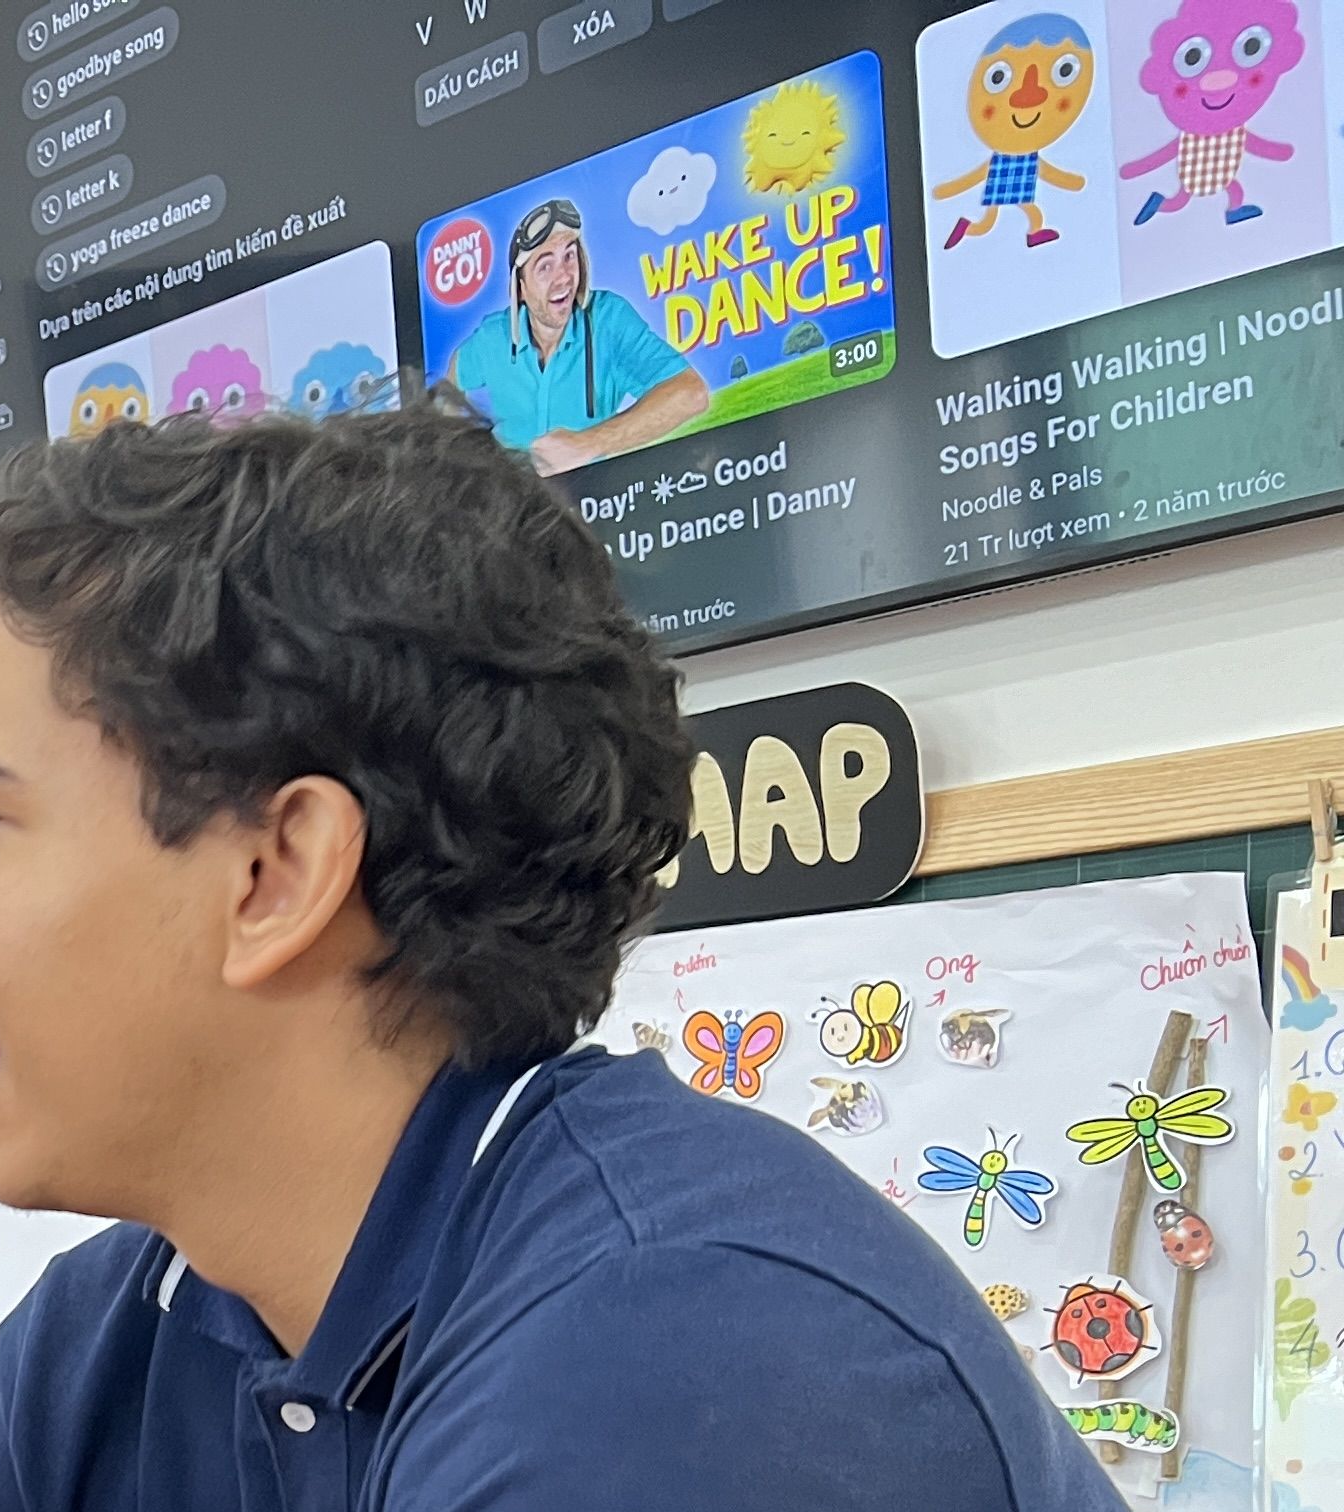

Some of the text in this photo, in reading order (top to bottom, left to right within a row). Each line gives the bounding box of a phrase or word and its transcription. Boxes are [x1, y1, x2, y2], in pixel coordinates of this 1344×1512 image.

[52, 2, 90, 34] hello
[415, 0, 487, 45] V W
[573, 10, 615, 44] XÓA
[57, 26, 164, 98] goodbye song
[424, 50, 519, 108] DẤU CÁCH
[61, 109, 113, 152] letter f
[65, 170, 121, 211] letter k
[70, 193, 212, 273] yoga freeze dance
[433, 229, 482, 265] DANNY
[640, 186, 857, 298] WAKE UP
[39, 195, 347, 340] Dựa trên các nội dung tìm kiếm đề xuất
[435, 247, 483, 293] GO!
[665, 225, 885, 354] DANCE!
[834, 339, 878, 369] 3:00
[935, 371, 1063, 426] Walking
[1072, 332, 1207, 389] Walking
[939, 374, 1254, 476] Songs For Children
[714, 440, 787, 487] Good
[942, 465, 1103, 522] Noodle & Pals
[943, 541, 969, 566] 21
[978, 532, 1001, 557] Tr
[1008, 521, 1055, 551] lượt
[1060, 512, 1111, 541] xem
[1133, 499, 1149, 522] 2
[1155, 485, 1210, 517] năm
[1216, 469, 1287, 503] trước
[619, 529, 654, 562] Up
[661, 507, 745, 549] Dance
[767, 478, 856, 522] Danny
[682, 598, 736, 627] trước
[925, 953, 982, 984] Ong
